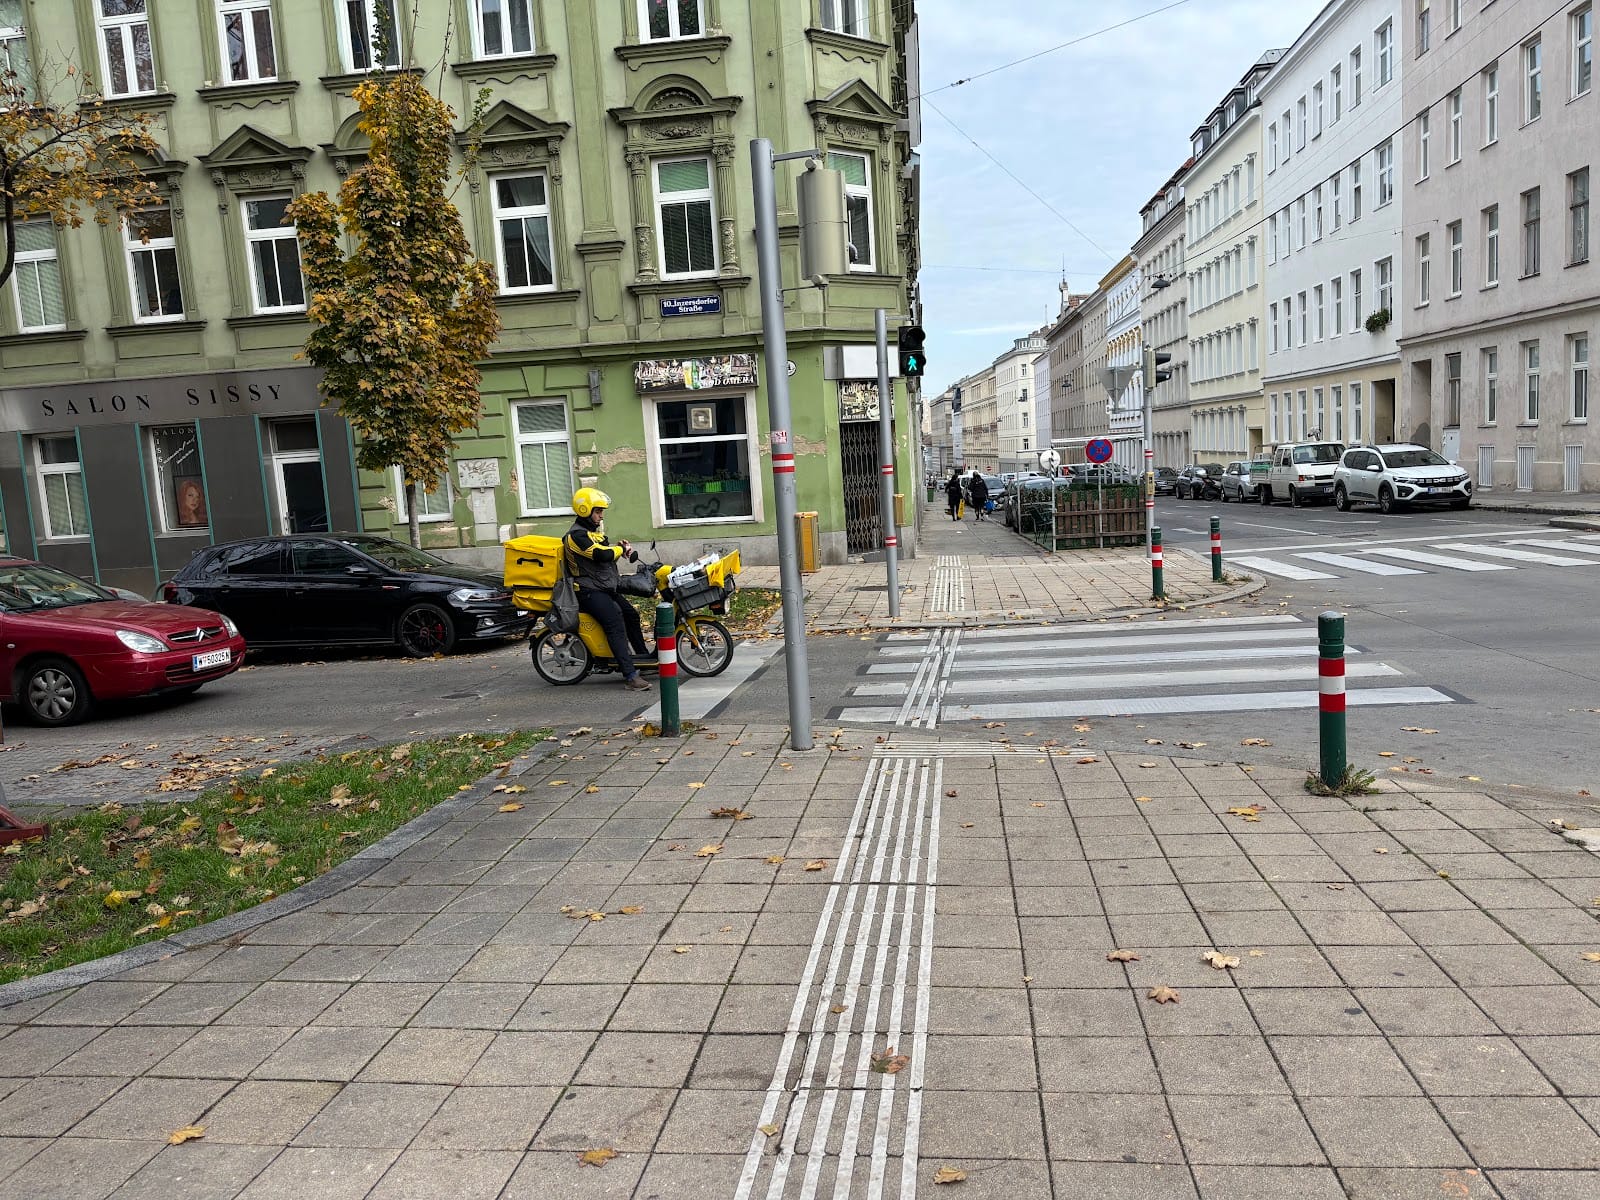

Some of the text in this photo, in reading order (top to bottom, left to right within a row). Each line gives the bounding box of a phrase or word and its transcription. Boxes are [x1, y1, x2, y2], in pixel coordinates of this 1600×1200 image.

[678, 305, 703, 313] Straße
[41, 383, 282, 417] SALON SISSY
[154, 427, 194, 436] SALON
